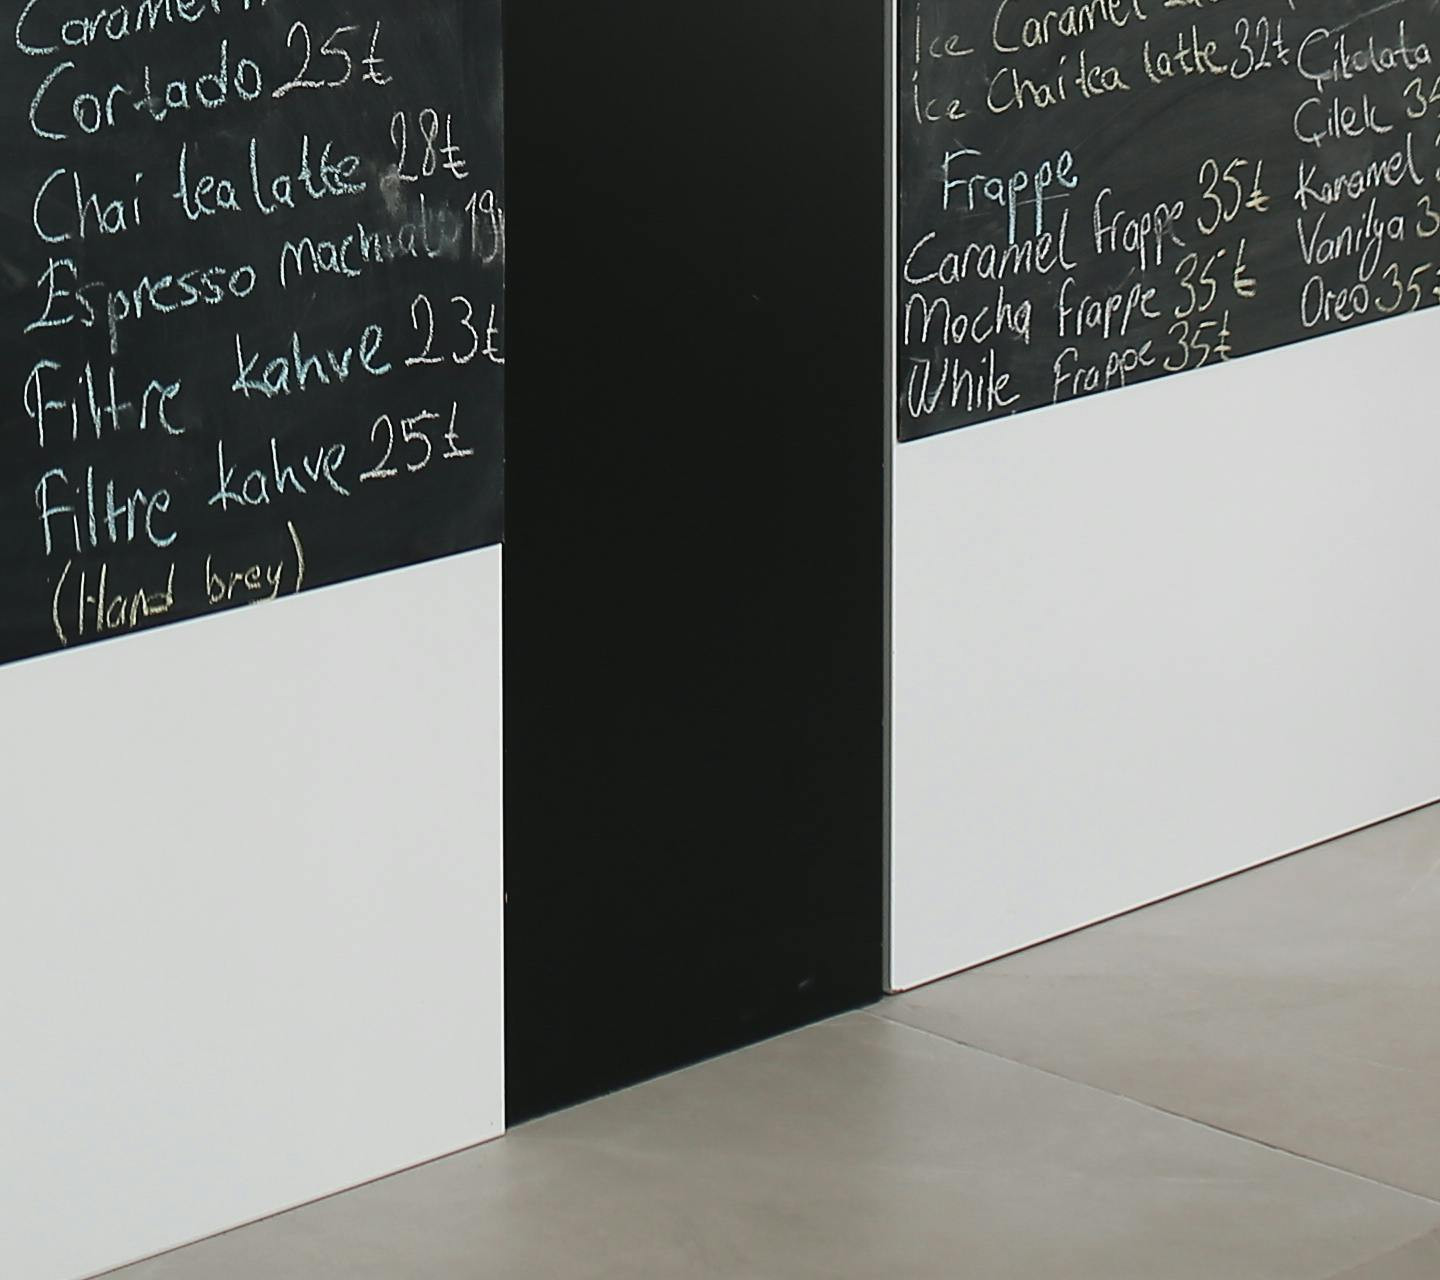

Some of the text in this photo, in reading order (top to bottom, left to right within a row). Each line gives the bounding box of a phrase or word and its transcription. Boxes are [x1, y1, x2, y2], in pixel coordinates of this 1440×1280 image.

[28, 39, 262, 140] Cortado
[986, 55, 1067, 115] Chai
[1296, 20, 1433, 92] Çikolata
[1293, 94, 1394, 147] Çilek
[32, 167, 144, 243] Chai
[173, 141, 242, 220] tea
[941, 148, 1080, 244] Frappe
[1294, 132, 1425, 210] Karamel
[903, 208, 1078, 285] Caramel
[1296, 196, 1405, 282] Vanilya
[23, 257, 256, 355] Espresso
[904, 285, 1033, 346] Mocha
[1300, 275, 1370, 328] Oreo
[23, 359, 186, 447] Filtre
[35, 465, 179, 555] Filtre
[51, 559, 176, 646] (Hand
